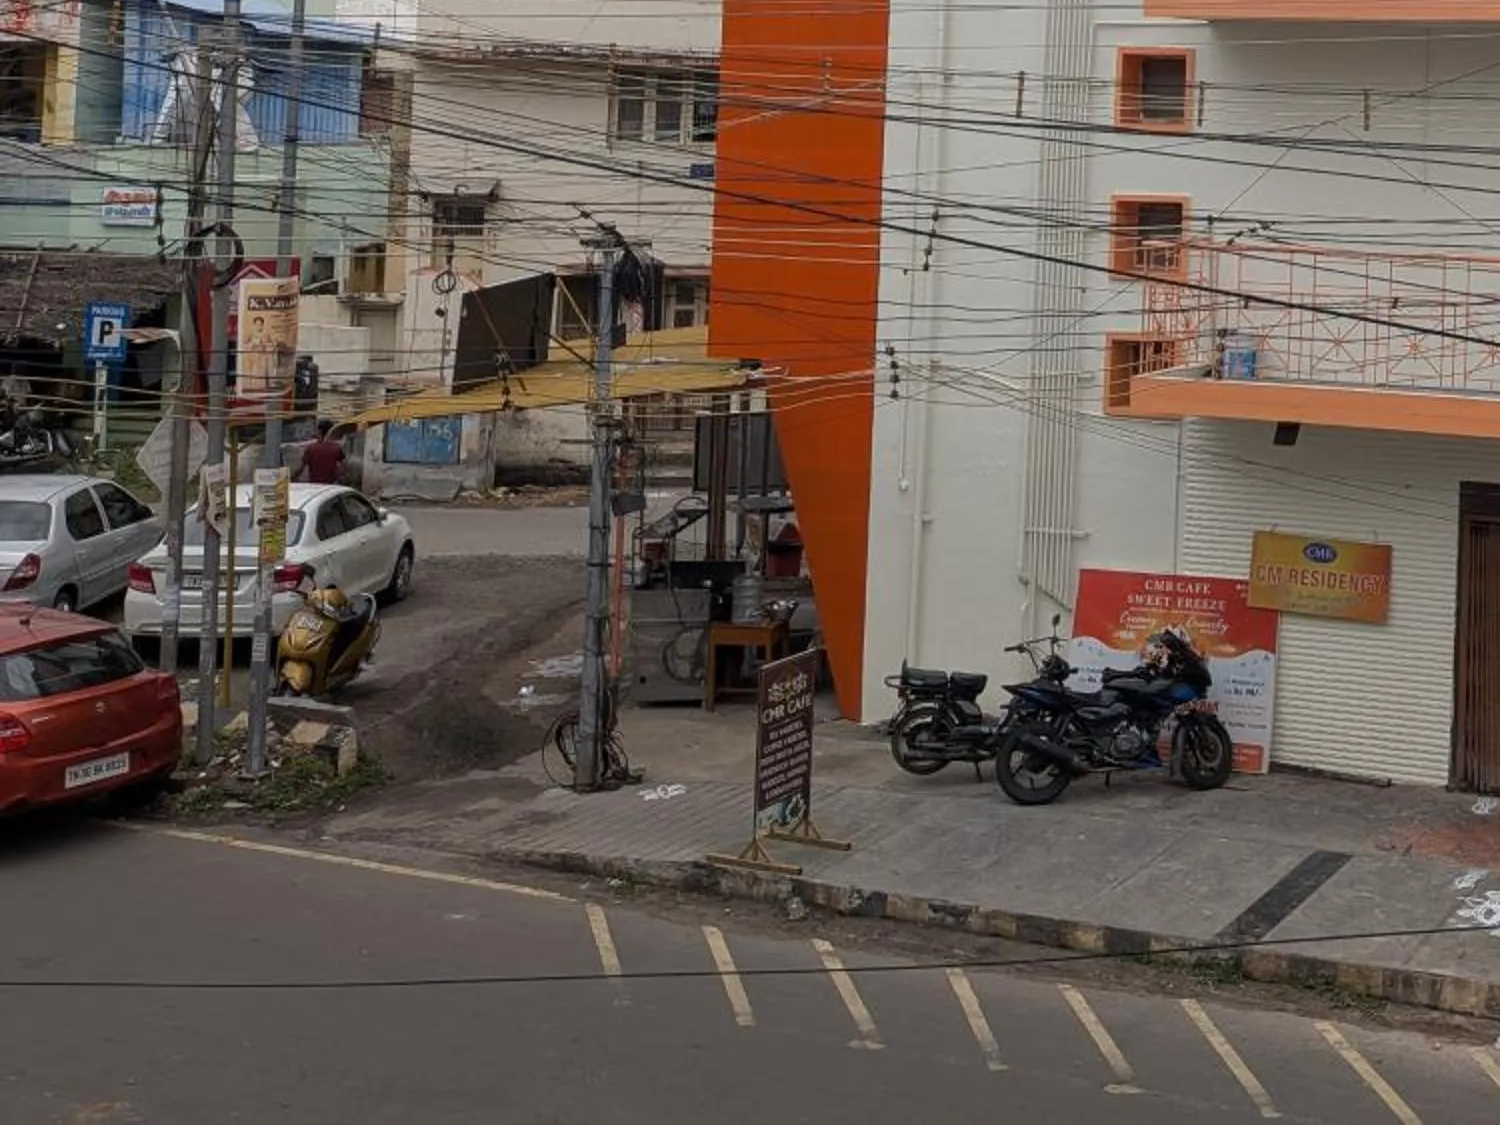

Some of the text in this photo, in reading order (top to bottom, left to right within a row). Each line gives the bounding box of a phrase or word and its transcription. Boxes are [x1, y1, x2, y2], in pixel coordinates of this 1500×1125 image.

[98, 320, 115, 345] P
[1176, 582, 1212, 595] CAFE
[1289, 568, 1387, 594] RESIDENCY
[1126, 594, 1171, 607] SWEET
